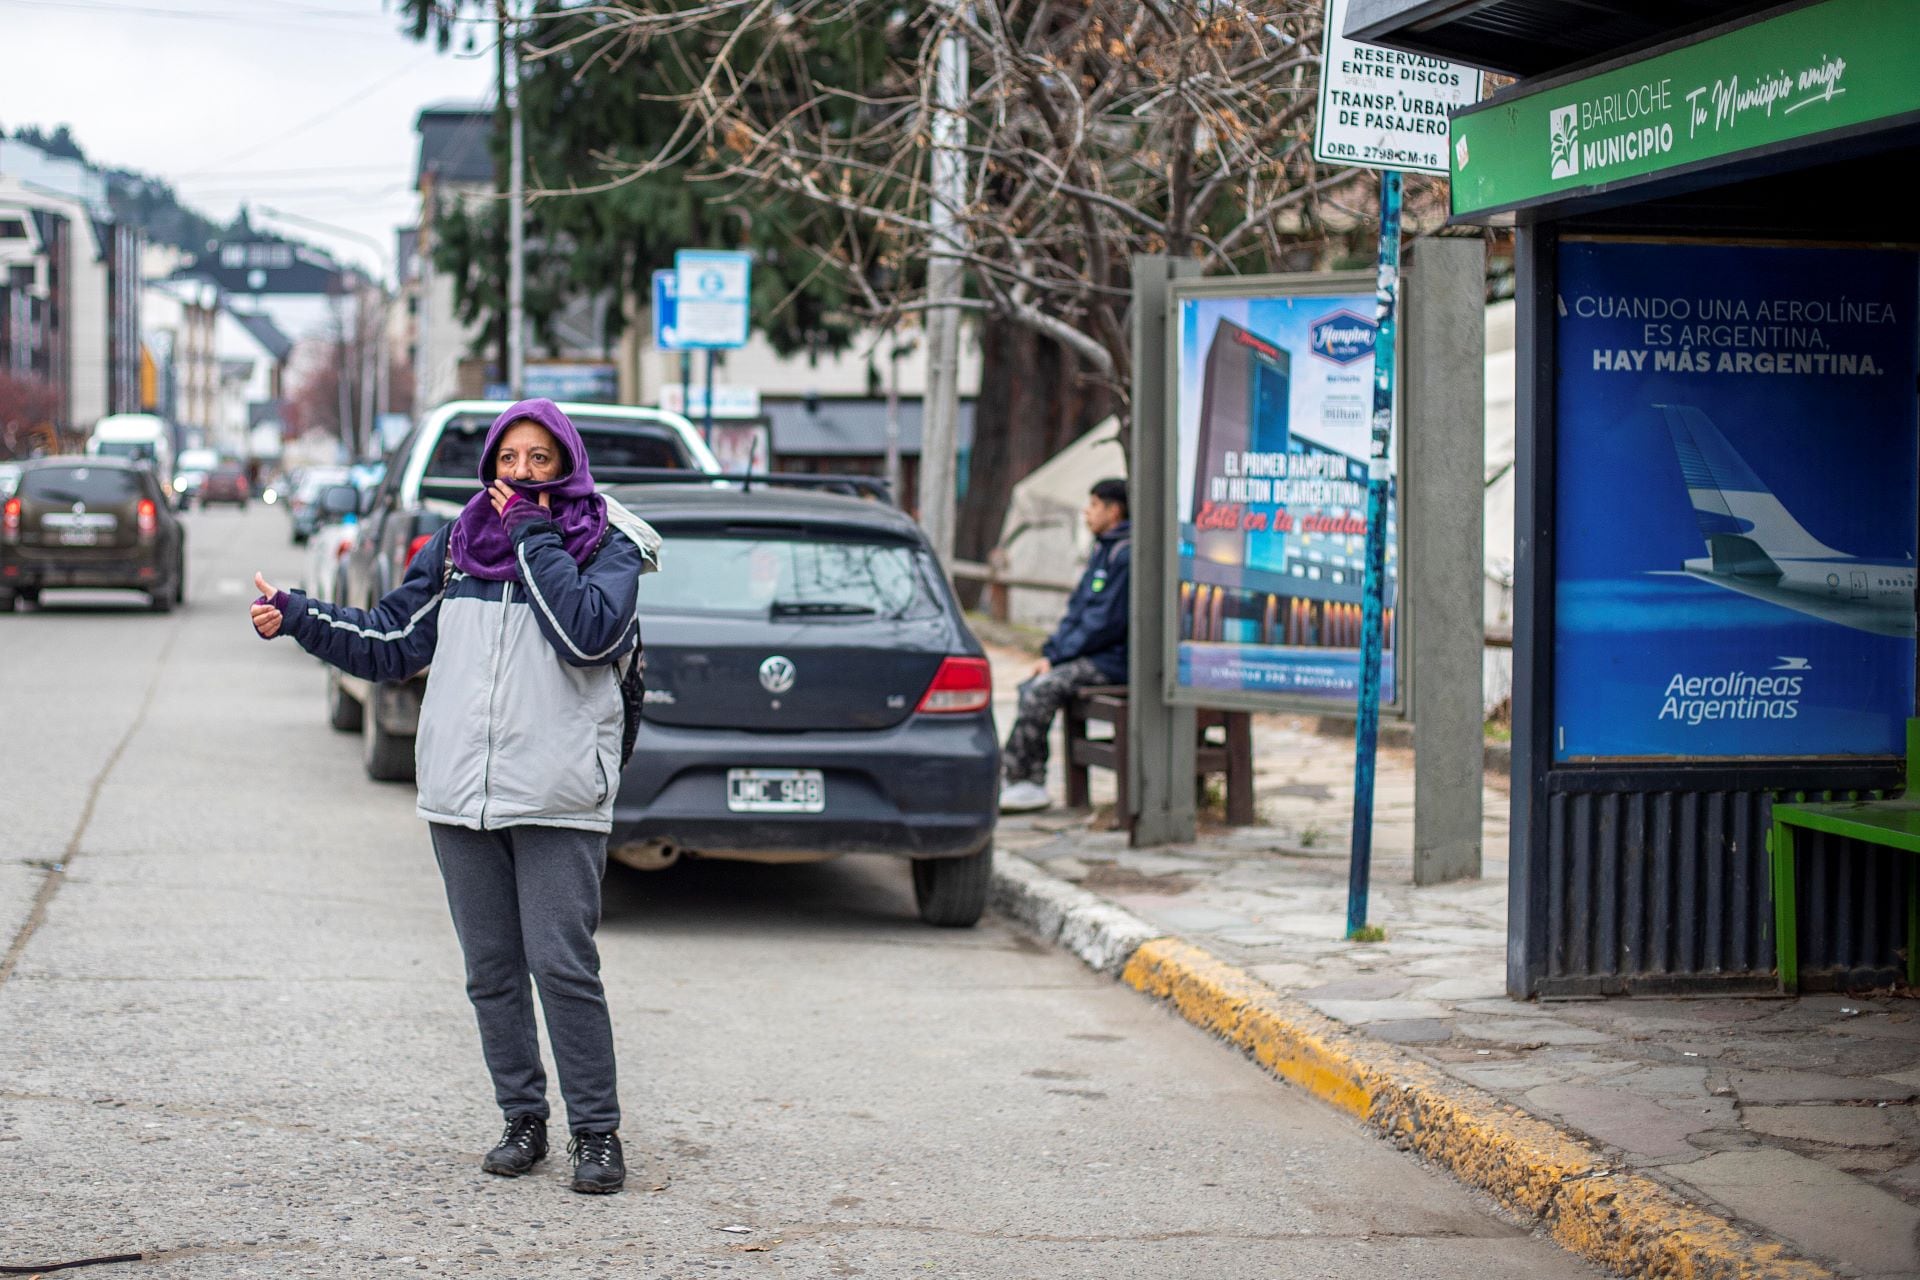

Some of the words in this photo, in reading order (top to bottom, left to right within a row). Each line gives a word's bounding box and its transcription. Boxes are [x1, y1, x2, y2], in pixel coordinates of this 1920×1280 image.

[1354, 47, 1450, 70] RESERVADO
[1342, 61, 1395, 78] ENTRE
[1401, 67, 1460, 86] DISCOS
[1331, 90, 1396, 111] TRANSP.
[1582, 78, 1672, 131] BARILOCHE
[1686, 86, 1709, 139] Tu
[1711, 74, 1794, 132] Municipio
[1798, 54, 1847, 103] amigo
[1339, 111, 1360, 126] DE
[1365, 113, 1447, 135] PASAJERO
[1327, 142, 1360, 156] ORD.
[1583, 125, 1673, 170] MUNICIPIO
[1575, 294, 1691, 321] CUANDO
[1698, 299, 1747, 322] UNA
[1755, 295, 1897, 325] AEROLÍNEA
[1644, 323, 1672, 346] ES
[1679, 325, 1831, 351] ARGENTINA,
[1593, 348, 1648, 372] HAY
[1654, 344, 1712, 373] MÁS
[1716, 351, 1885, 376] ARGENTINA.
[1226, 453, 1240, 475] EL
[1242, 452, 1287, 478] PRIMER
[1288, 454, 1348, 480] HAMPTON
[1213, 479, 1228, 501] BY
[1229, 478, 1271, 503] HILTON
[1273, 479, 1289, 503] DE
[1289, 480, 1361, 505] ARGENTINA
[1243, 511, 1268, 531] en
[1664, 670, 1804, 697] Aerolíneas
[1658, 696, 1800, 726] Argentinas
